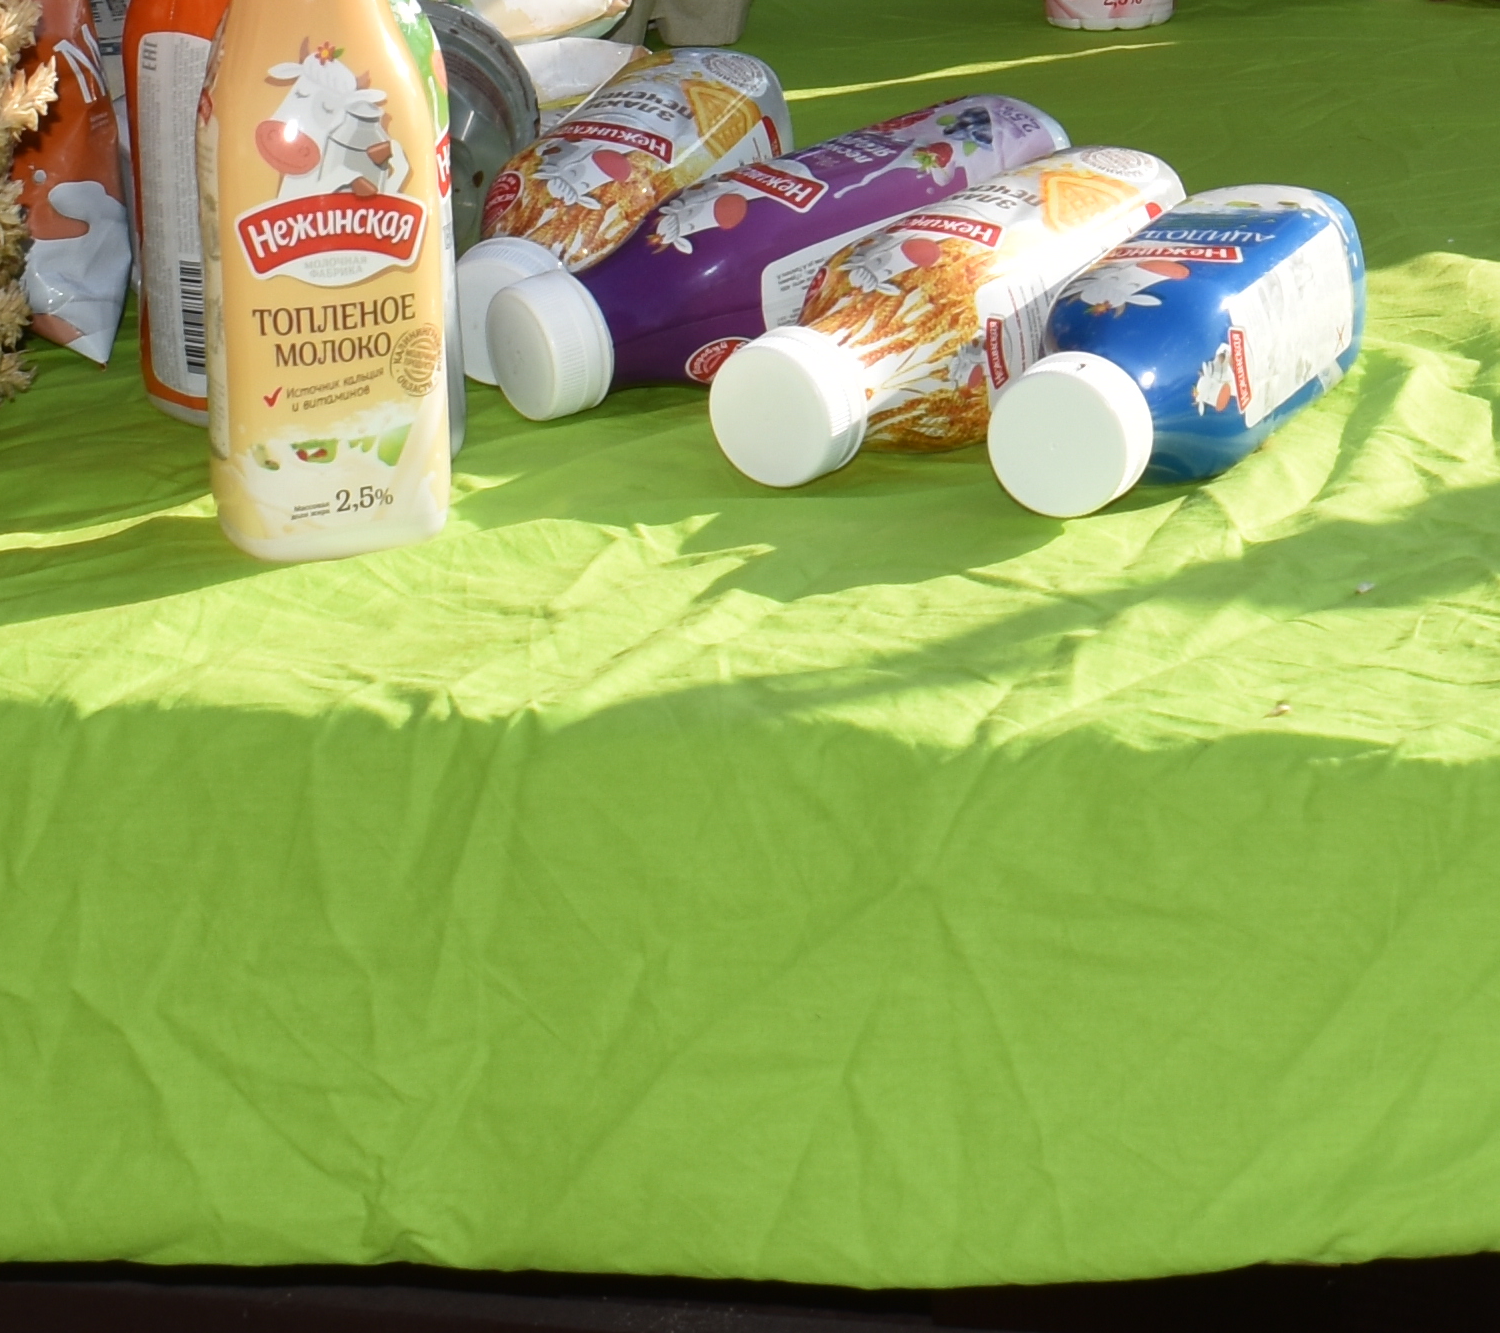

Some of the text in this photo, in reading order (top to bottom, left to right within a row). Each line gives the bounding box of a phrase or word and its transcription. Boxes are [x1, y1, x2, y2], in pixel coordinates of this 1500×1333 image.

[247, 207, 415, 259] Нежинская
[304, 255, 368, 270] МОЛОЧНАЯ
[309, 265, 364, 279] ФАБРИКА
[252, 293, 416, 336] ТОПЛЕНОЕ
[274, 331, 393, 368] МОЛОКО
[286, 367, 385, 399] Источник кальция
[291, 385, 371, 412] и витаминов
[335, 486, 394, 514] 2,5%
